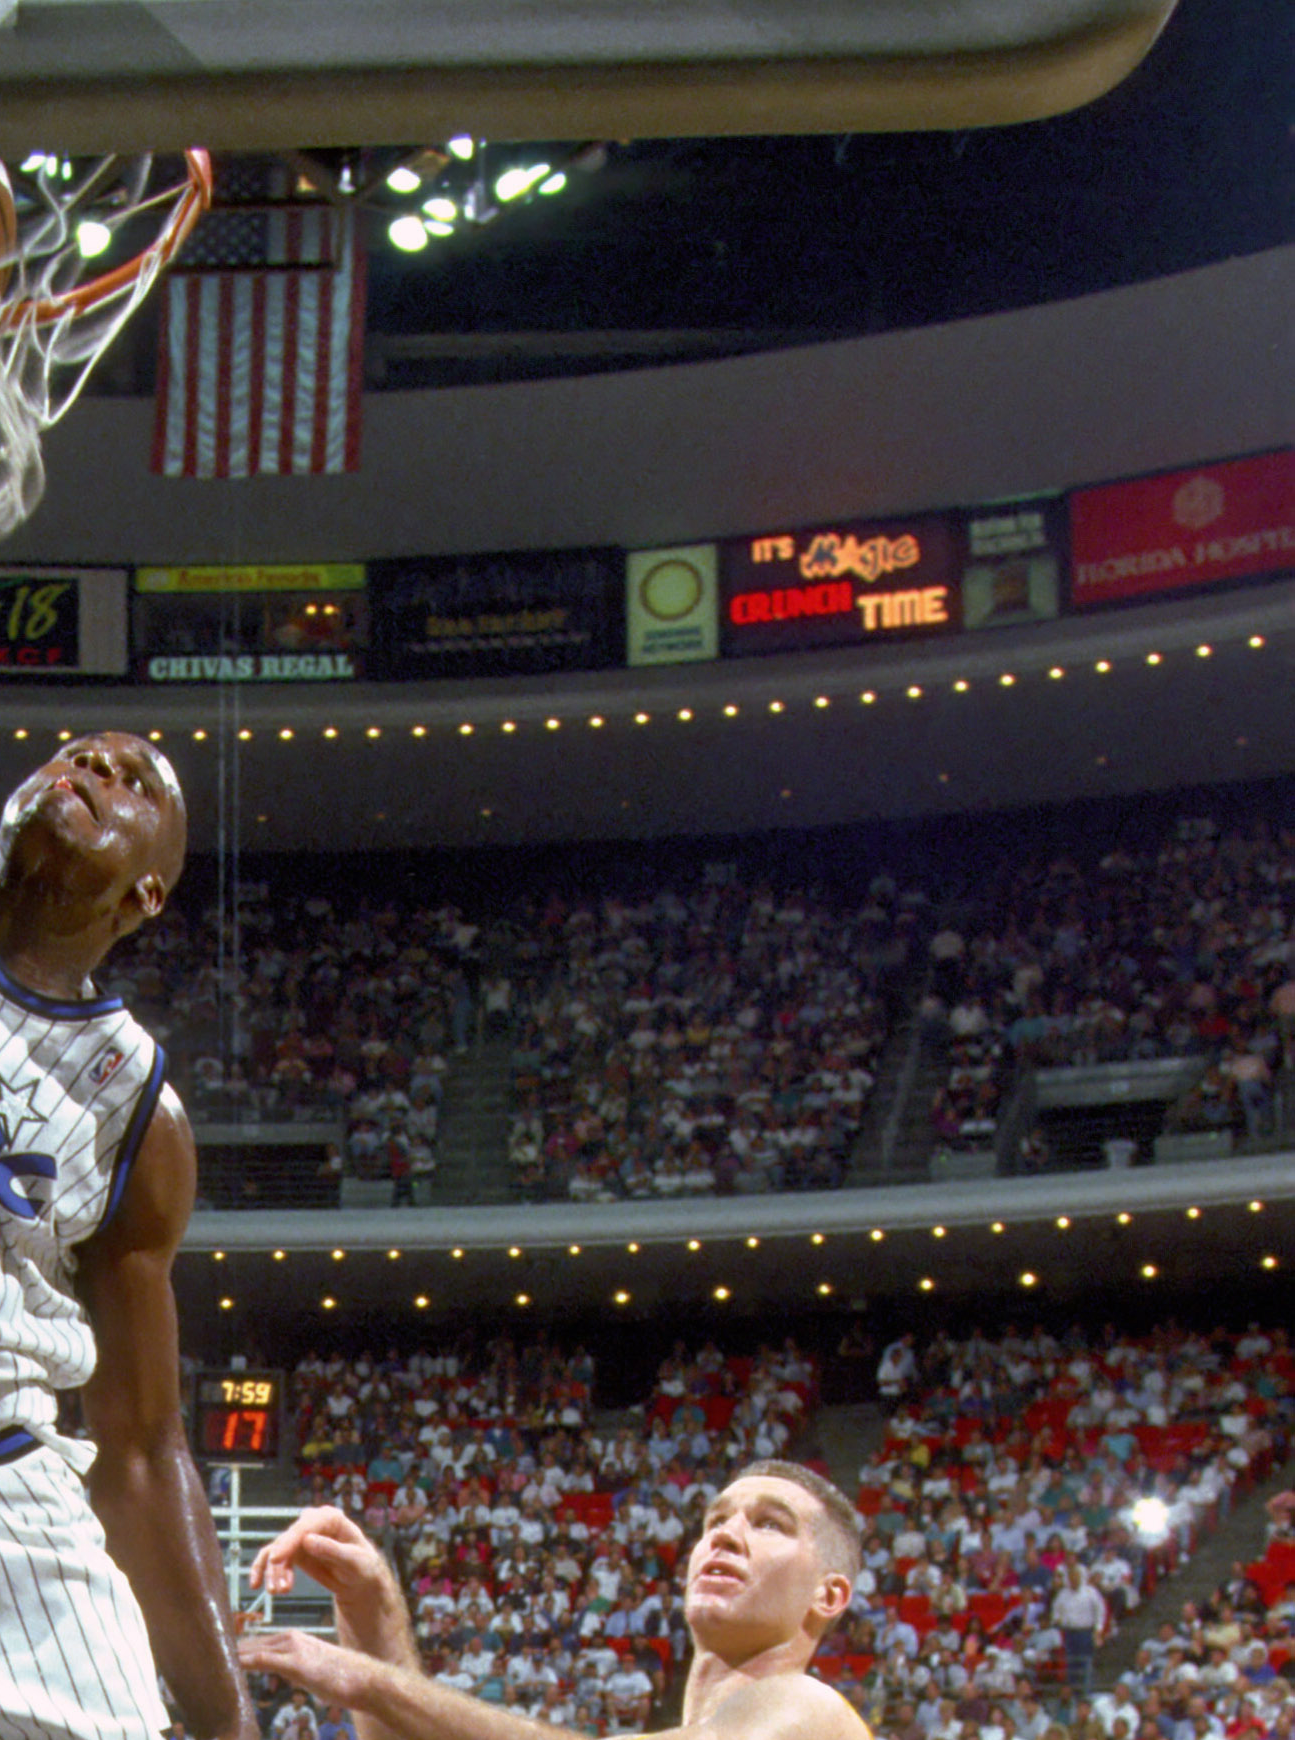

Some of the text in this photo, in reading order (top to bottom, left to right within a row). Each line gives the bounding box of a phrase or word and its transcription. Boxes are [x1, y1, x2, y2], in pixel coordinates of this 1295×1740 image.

[752, 535, 794, 563] IT'S
[730, 581, 948, 631] CRUNCH TIME
[148, 653, 354, 681] CHIVAS REGAL
[221, 1381, 272, 1405] 7:59
[223, 1411, 267, 1451] 17
